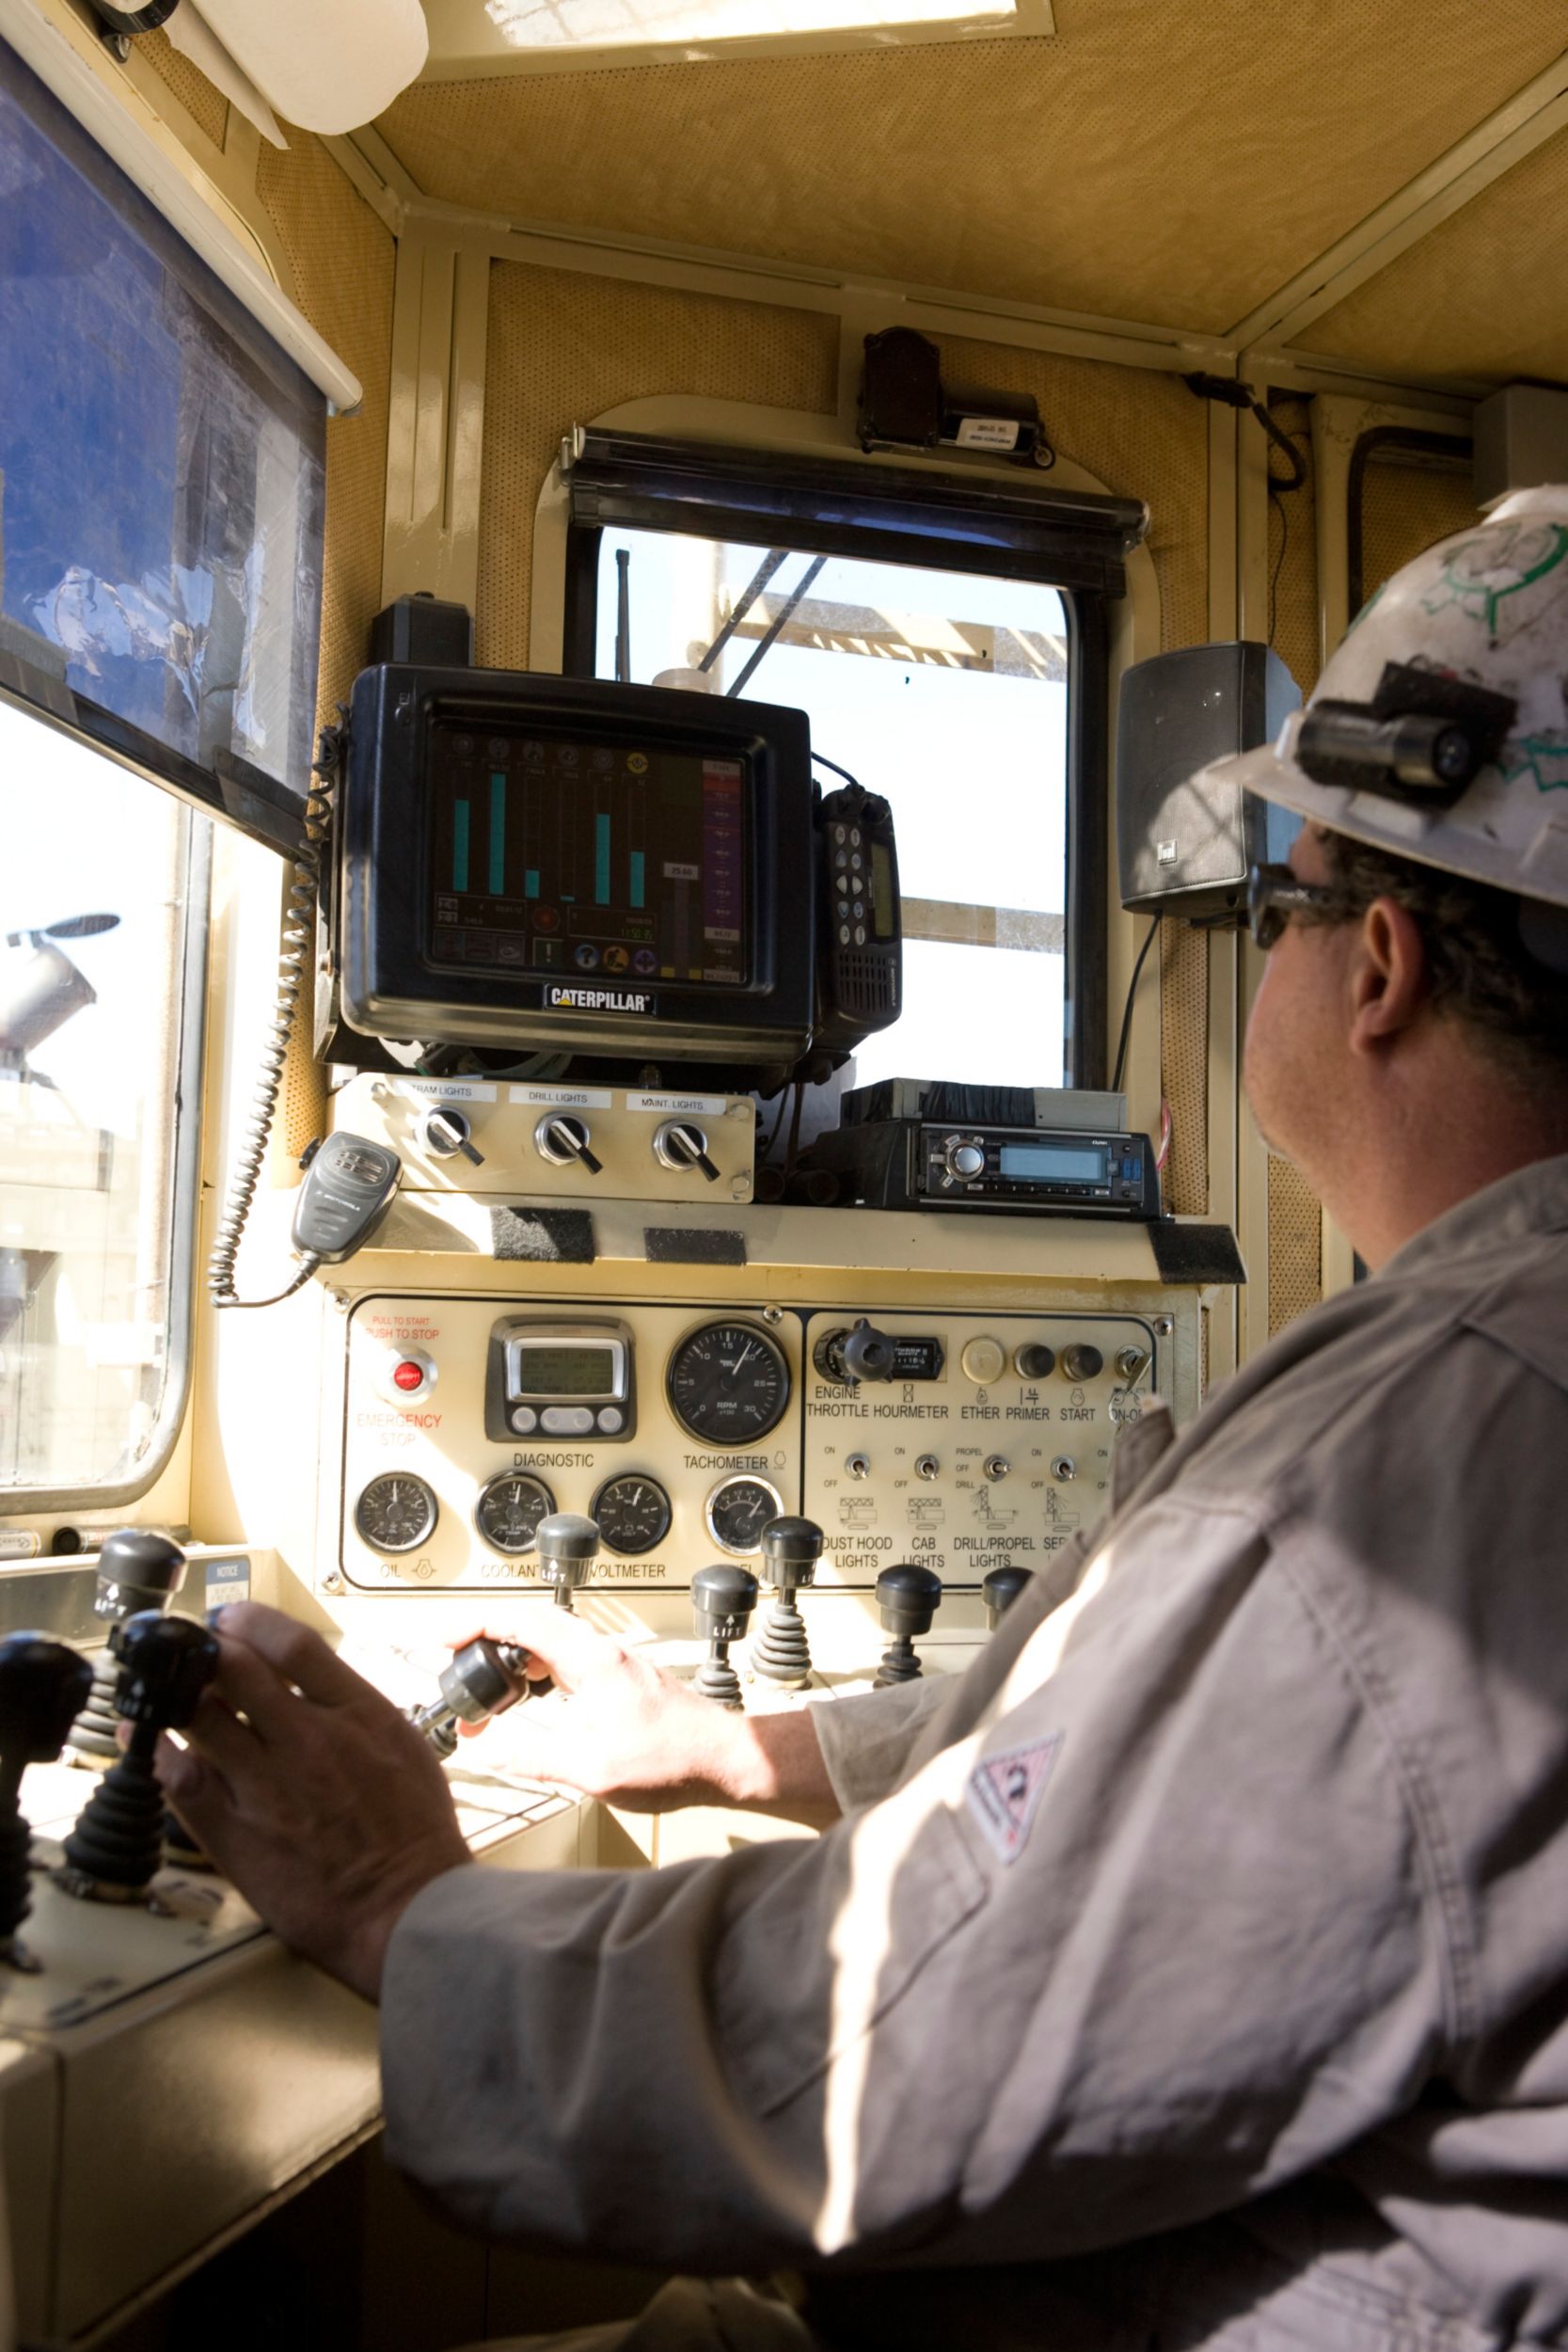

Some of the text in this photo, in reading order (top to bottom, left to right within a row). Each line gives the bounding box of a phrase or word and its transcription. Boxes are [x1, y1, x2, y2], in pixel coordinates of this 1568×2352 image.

[551, 987, 646, 1012] CATERPILLAR
[413, 1084, 472, 1097] TRAM LIGHTS
[529, 1091, 588, 1104] DRILL LIGHTS
[641, 1098, 704, 1110] MAINT. LIGHTS
[372, 1316, 430, 1326] PULL TO START
[395, 1328, 410, 1340] TO
[412, 1328, 439, 1340] STOP
[721, 1342, 734, 1350] 15
[688, 1378, 695, 1387] 5
[816, 1385, 862, 1400] ENGINE
[806, 1403, 949, 1420] THROTTLE HOURMETER
[960, 1406, 1000, 1420] ETHER
[1006, 1406, 1051, 1422] PRIMER
[1059, 1407, 1097, 1422] START
[356, 1413, 442, 1428] EMERGENCY
[380, 1432, 416, 1446] STOP
[824, 1446, 836, 1454] ON
[894, 1447, 906, 1455] ON
[955, 1447, 984, 1456] PROPEL
[1031, 1448, 1042, 1457] ON
[1097, 1449, 1108, 1458] ON
[514, 1453, 594, 1468] DIAGNOSTIC
[683, 1454, 768, 1470] TACHOMETER
[955, 1464, 970, 1472] OFF
[823, 1479, 838, 1488] OFF
[894, 1480, 909, 1488] OFF
[955, 1480, 975, 1489] DRILL
[1031, 1481, 1044, 1489] OFF
[823, 1536, 893, 1550] DUST HOOD
[911, 1536, 937, 1550] CAB
[953, 1536, 1037, 1550] DRILL/PROPEL
[834, 1554, 879, 1568] LIGHTS
[903, 1554, 945, 1568] LIGHTS
[969, 1553, 1012, 1568] LIGHTS
[380, 1564, 401, 1578] OIL
[481, 1564, 540, 1578] COOLAN
[713, 1626, 740, 1638] LIFT
